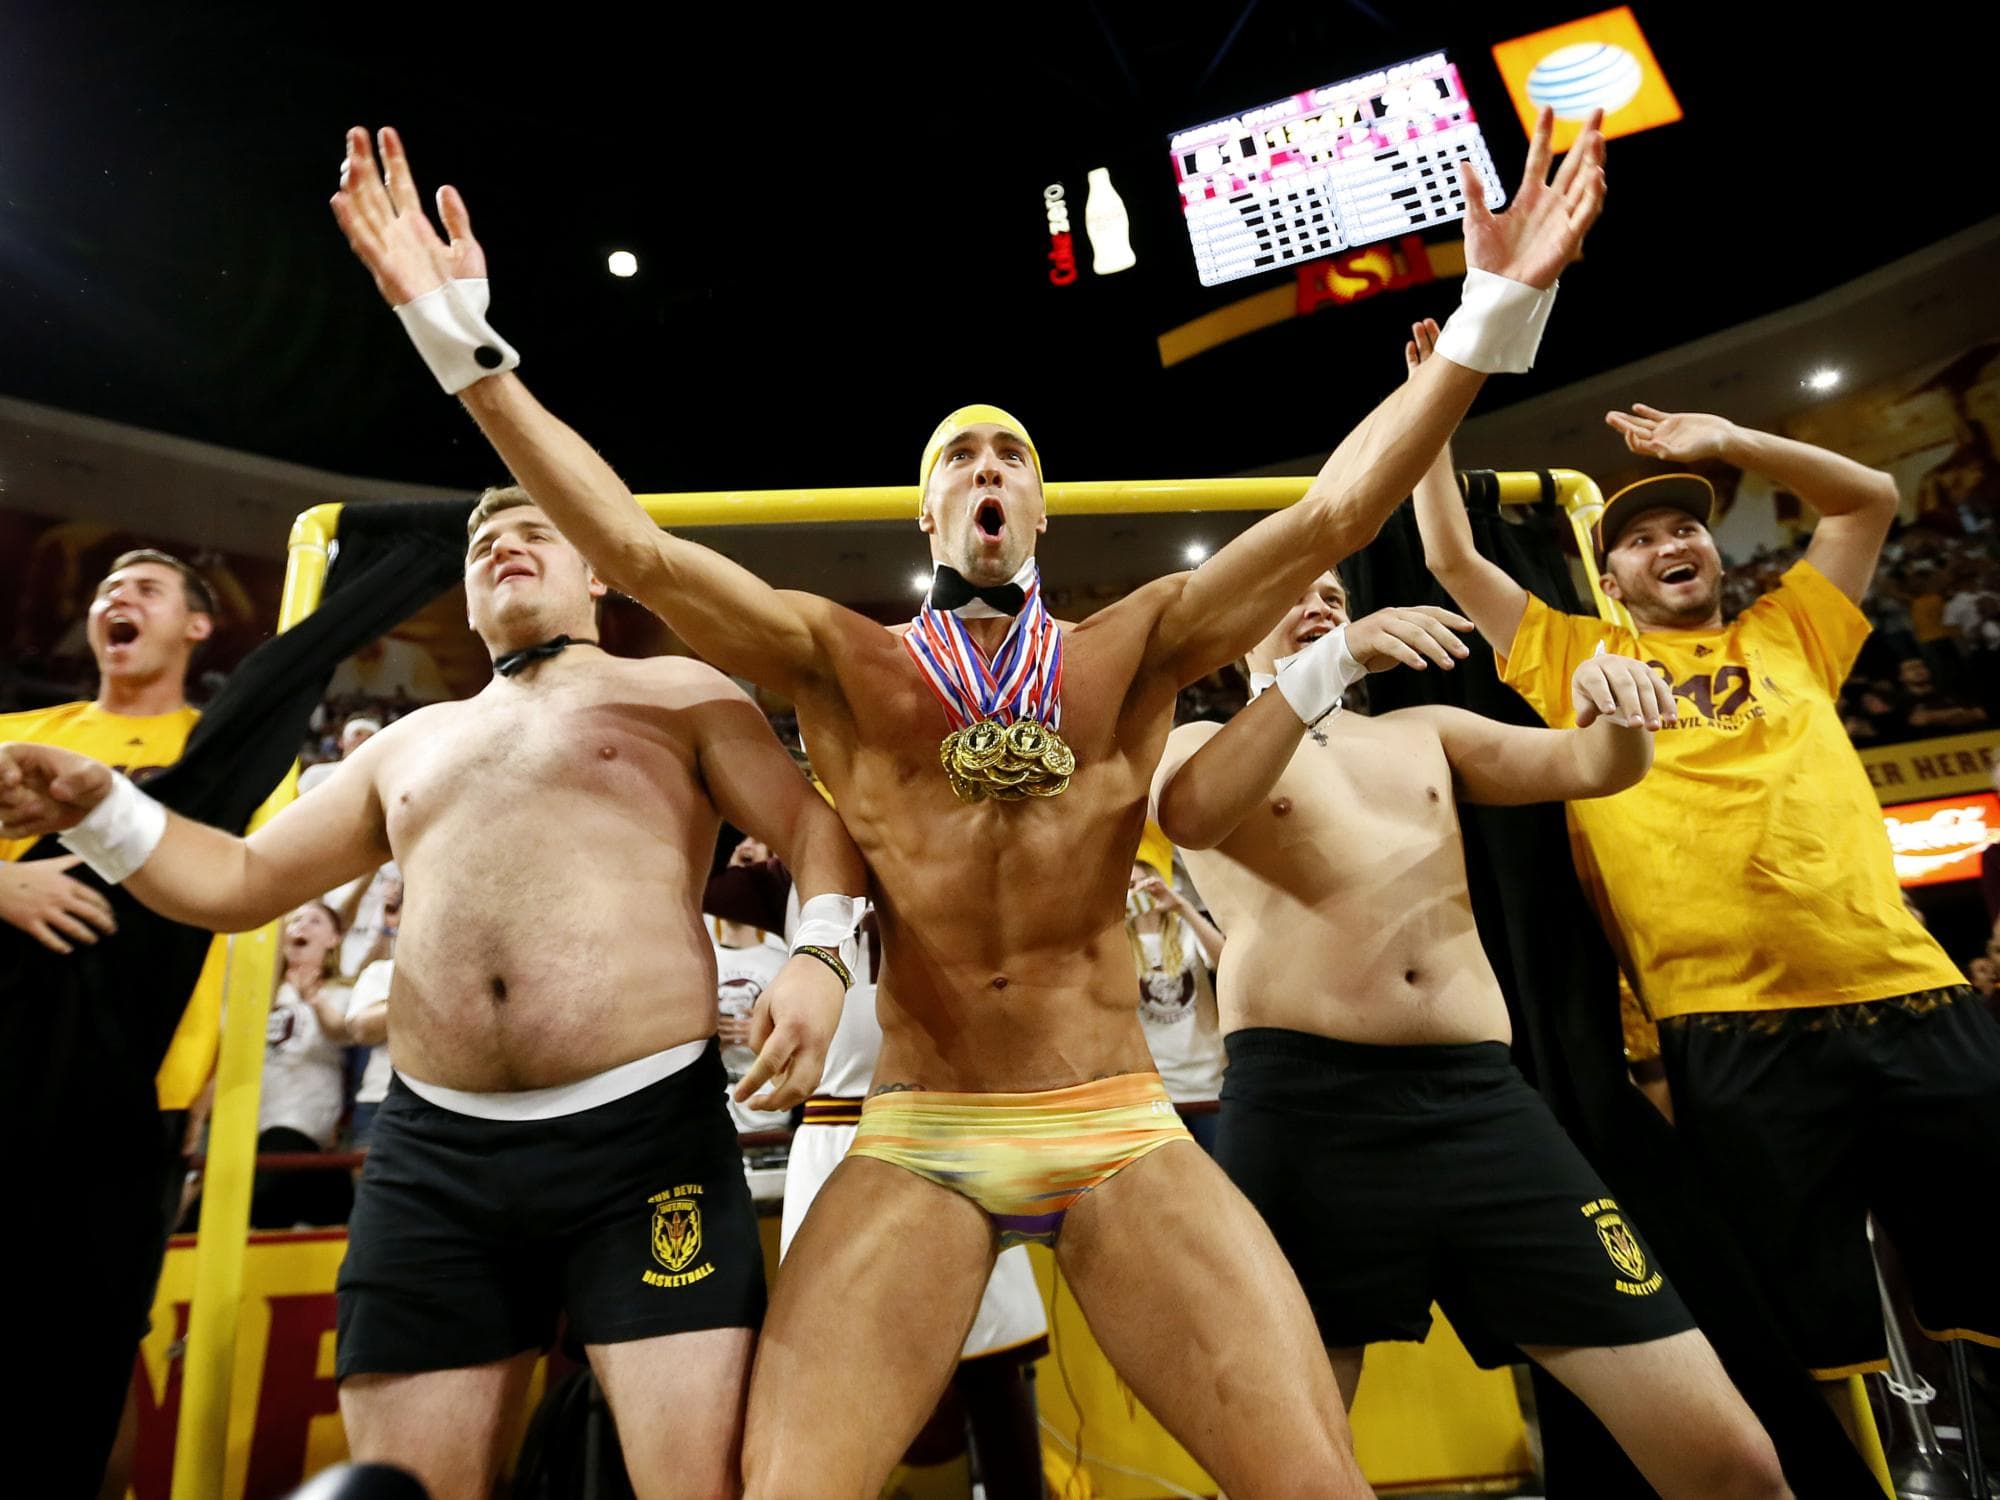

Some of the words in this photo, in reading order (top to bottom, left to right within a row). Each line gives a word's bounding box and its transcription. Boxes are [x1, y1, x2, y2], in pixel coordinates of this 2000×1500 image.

[1296, 235, 1435, 316] ASU
[673, 1184, 704, 1197] DEVIL
[642, 1262, 716, 1287] BASKETBALL
